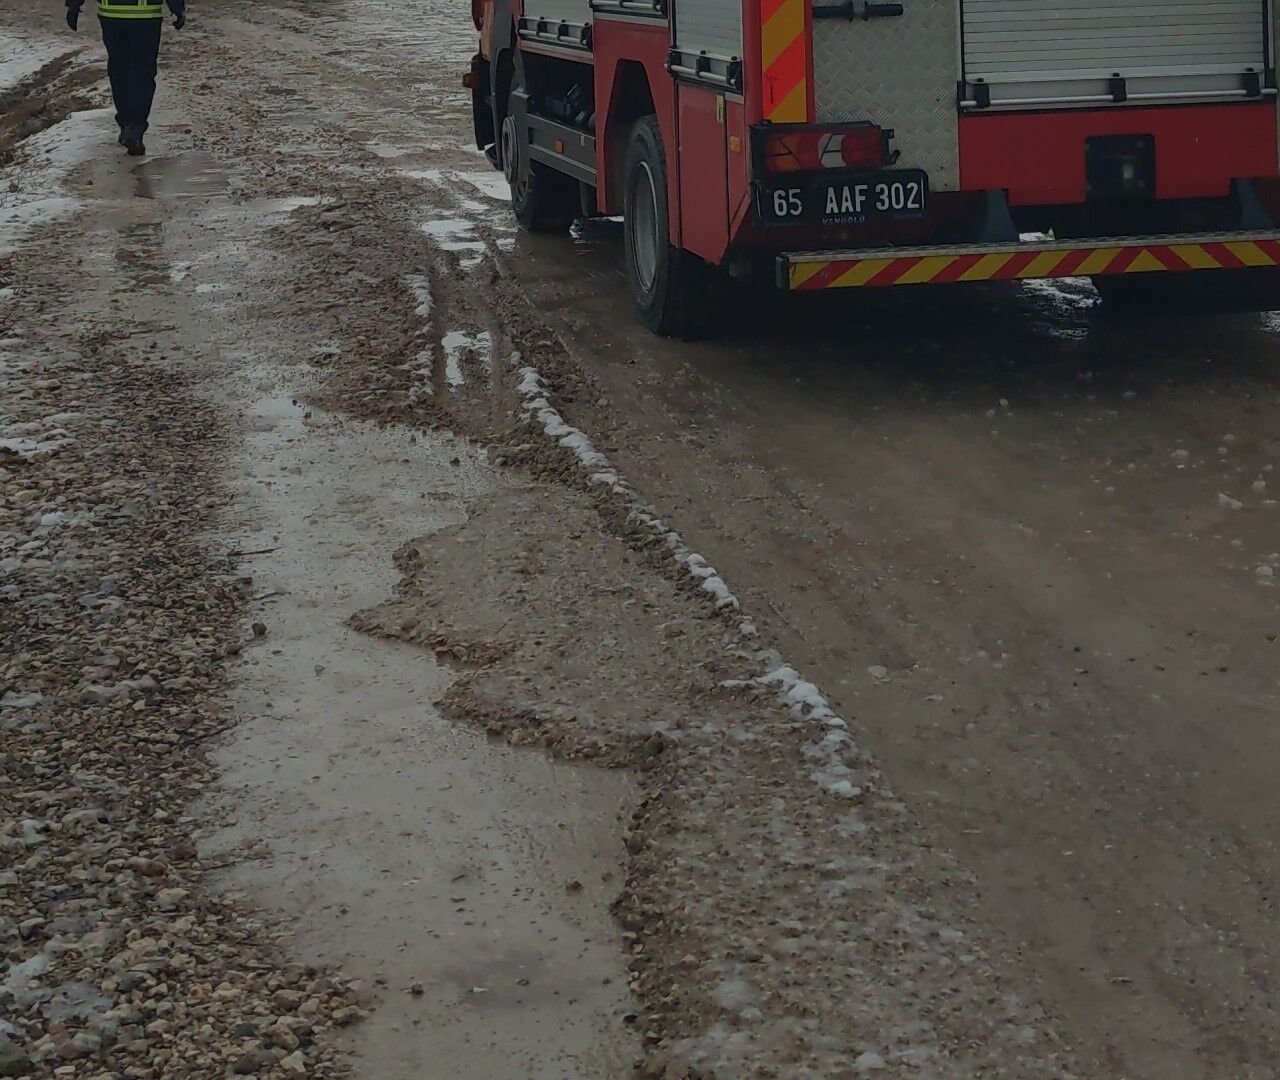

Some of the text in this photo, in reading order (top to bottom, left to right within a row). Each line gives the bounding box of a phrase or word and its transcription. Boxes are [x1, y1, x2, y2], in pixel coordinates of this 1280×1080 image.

[773, 182, 920, 216] 65 AAF 302
